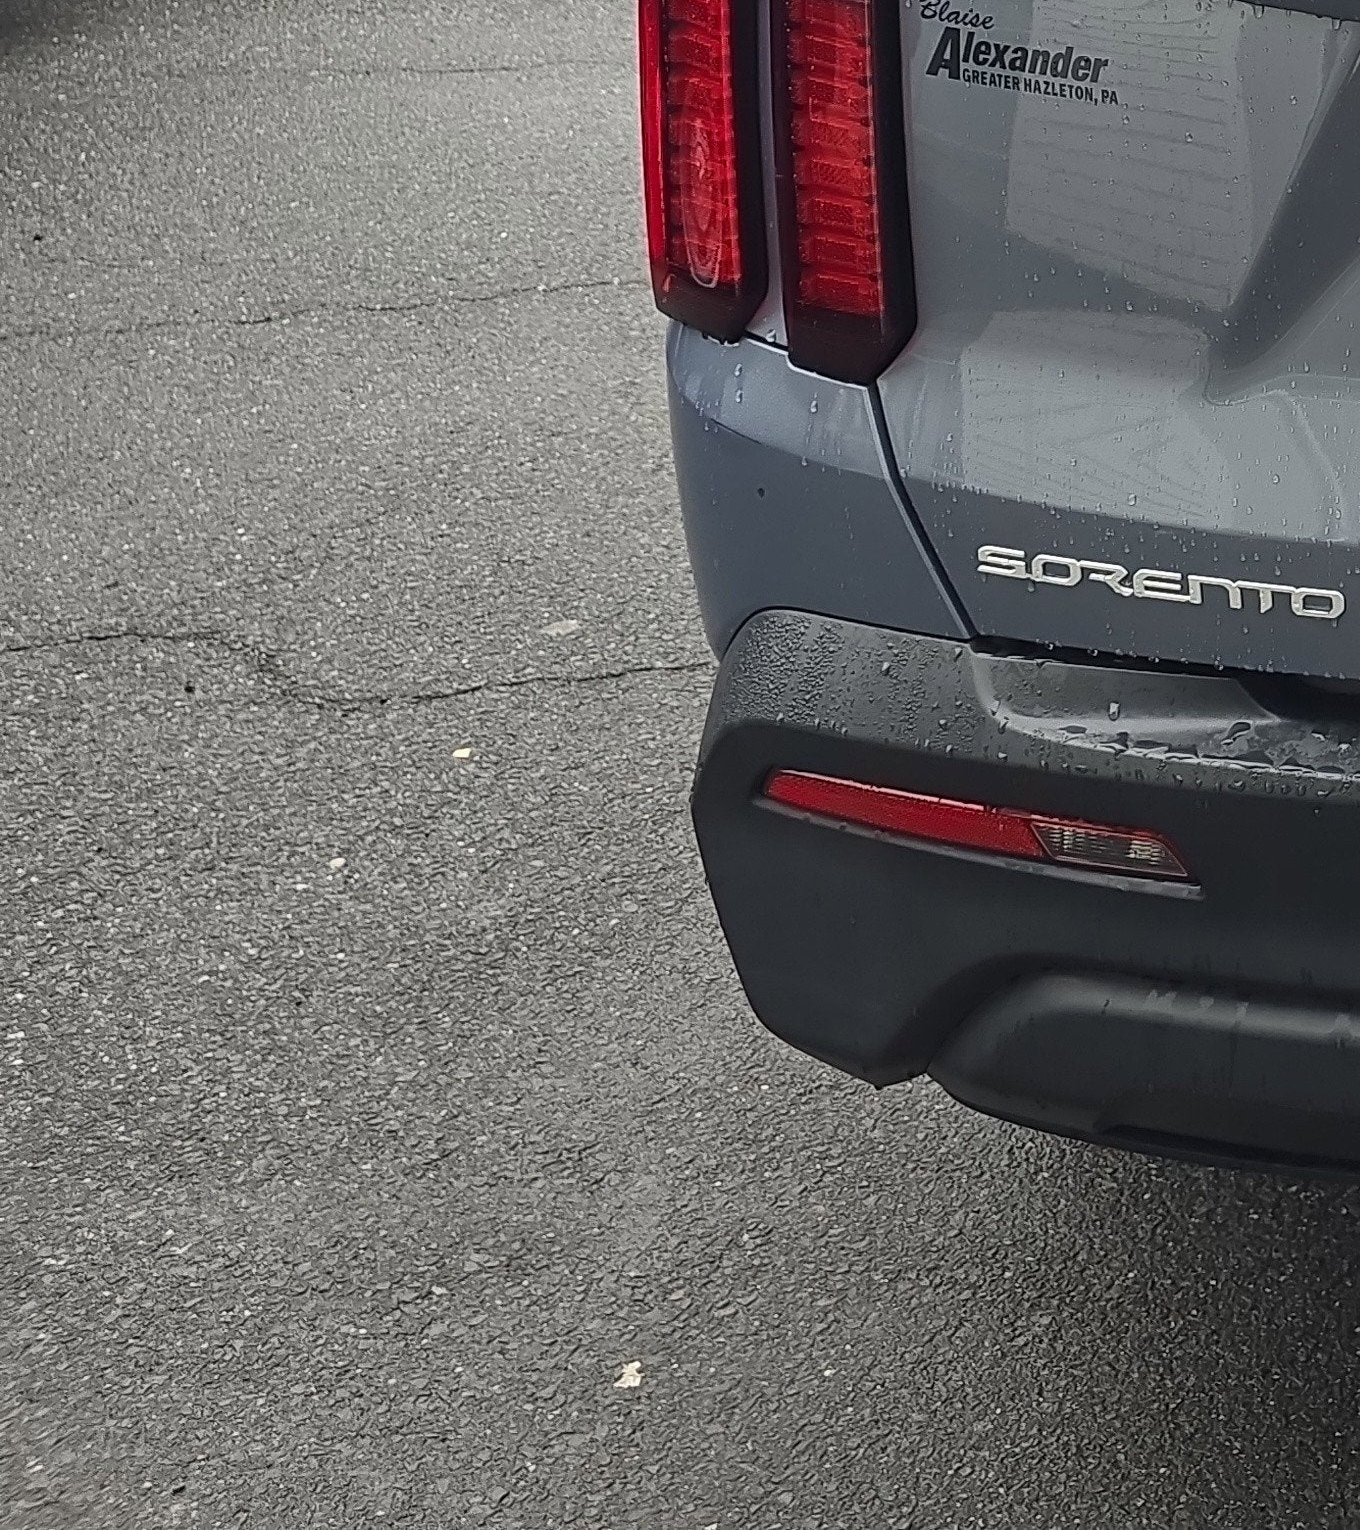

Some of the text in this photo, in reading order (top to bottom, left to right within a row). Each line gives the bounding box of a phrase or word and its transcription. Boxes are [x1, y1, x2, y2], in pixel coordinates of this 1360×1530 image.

[925, 25, 1110, 84] Alexander
[962, 67, 1119, 106] GREATER HAZLETON, PA
[977, 544, 1346, 620] SORENTO
